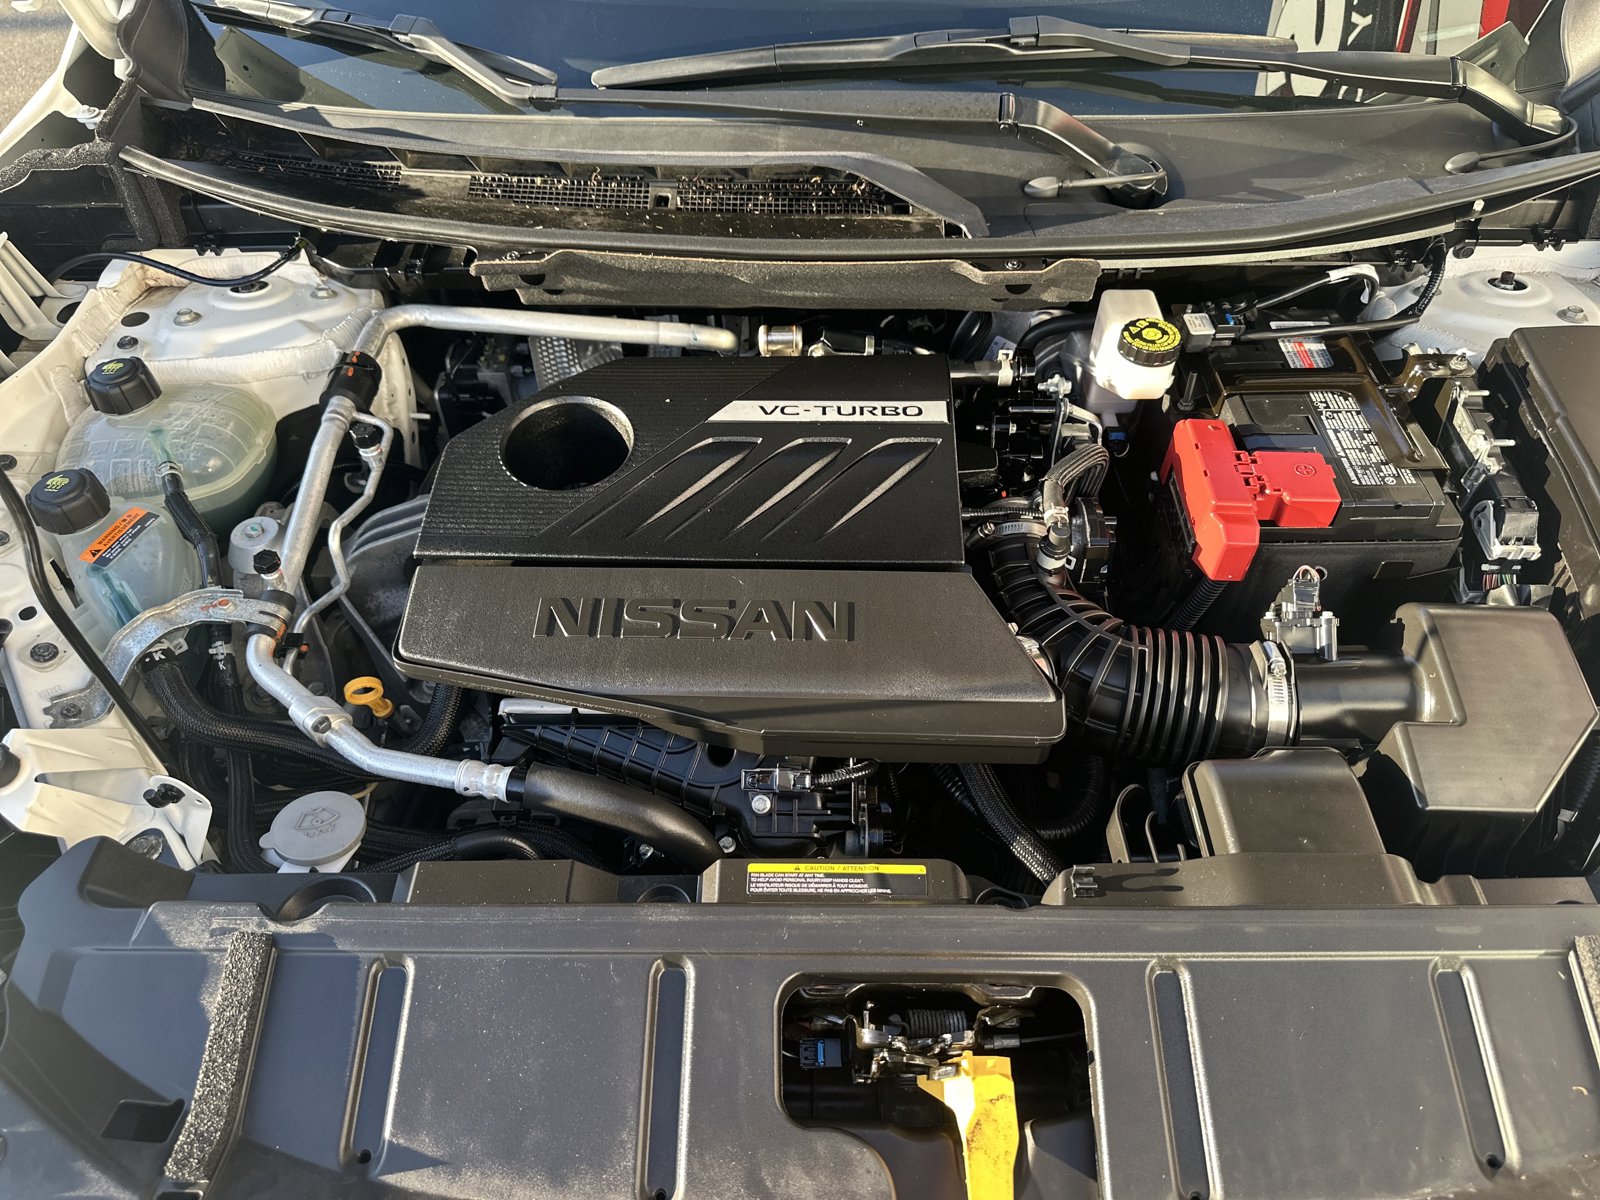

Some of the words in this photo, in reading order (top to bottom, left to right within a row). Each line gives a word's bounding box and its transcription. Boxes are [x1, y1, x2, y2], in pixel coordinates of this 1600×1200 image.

[758, 403, 924, 418] VC-TURBO
[97, 525, 120, 545] WARNING
[103, 514, 140, 547] AVERTISSEMENT
[532, 596, 856, 643] NISSAN
[152, 651, 166, 661] K
[218, 661, 226, 670] K
